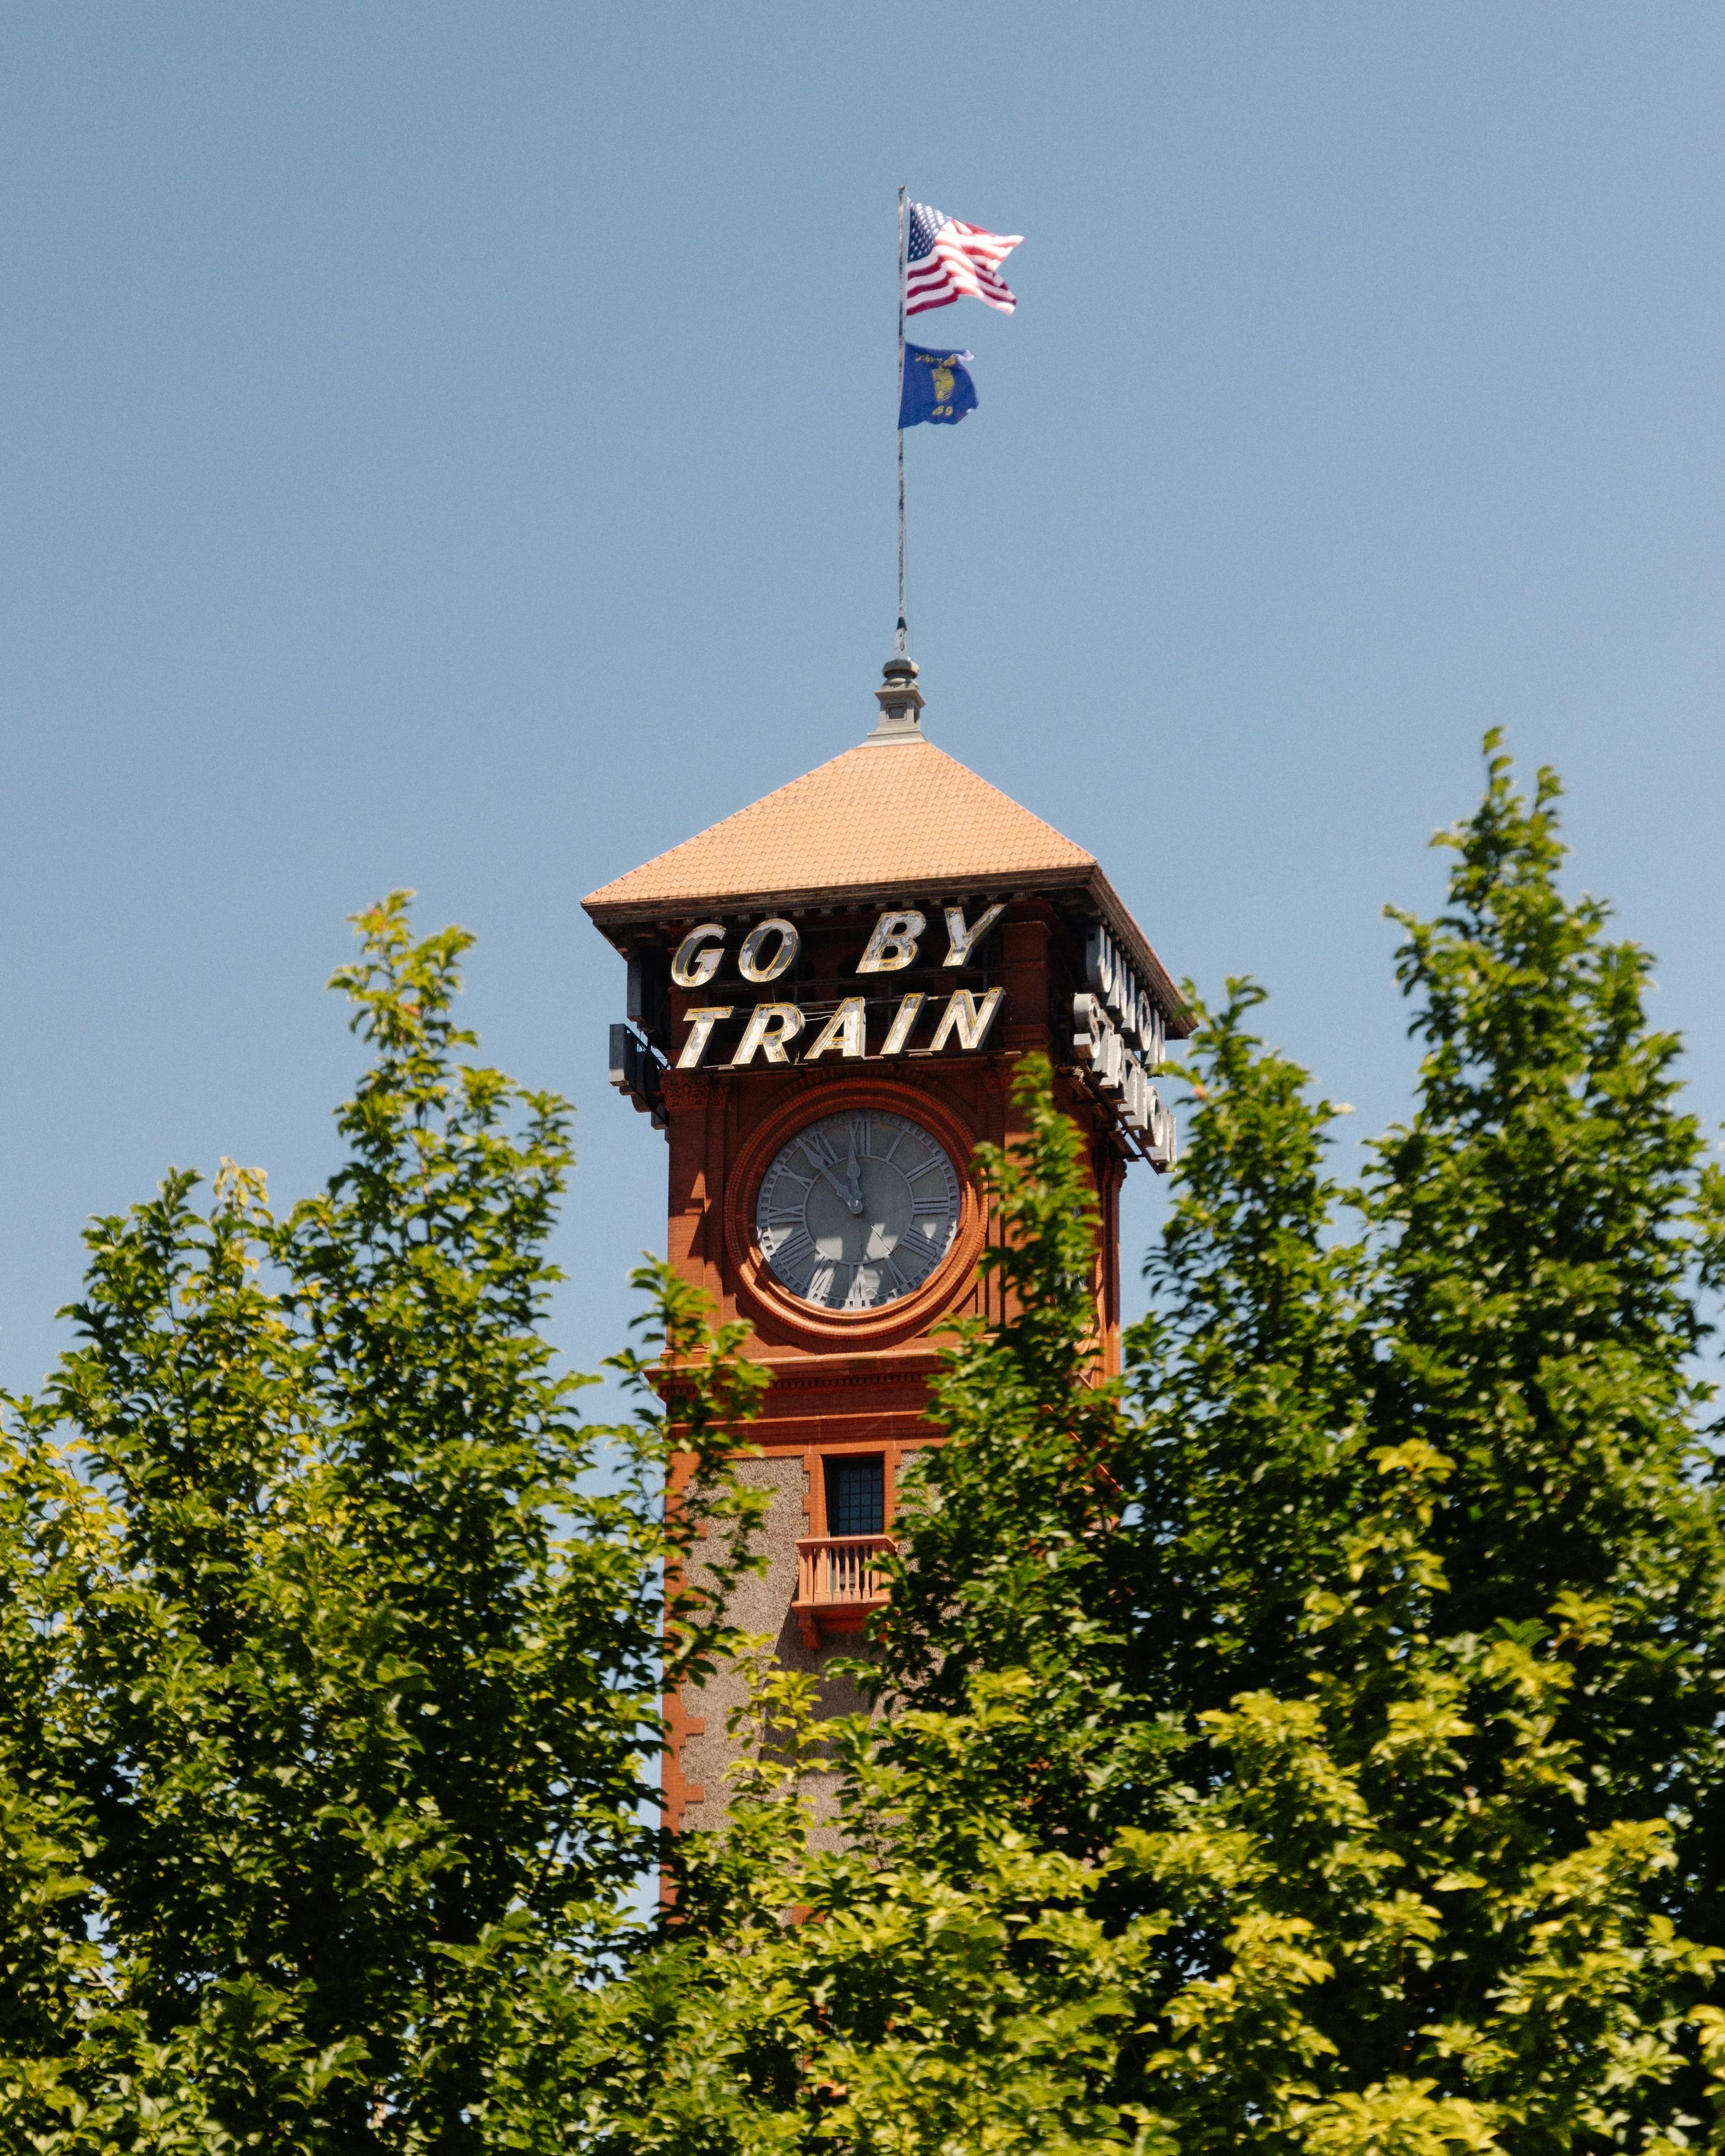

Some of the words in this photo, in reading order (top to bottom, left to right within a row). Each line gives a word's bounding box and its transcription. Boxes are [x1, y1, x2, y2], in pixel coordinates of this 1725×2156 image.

[671, 918, 800, 987] GO
[856, 903, 1007, 973] BY
[676, 987, 1006, 1069] TRAIN
[913, 1197, 949, 1215] III
